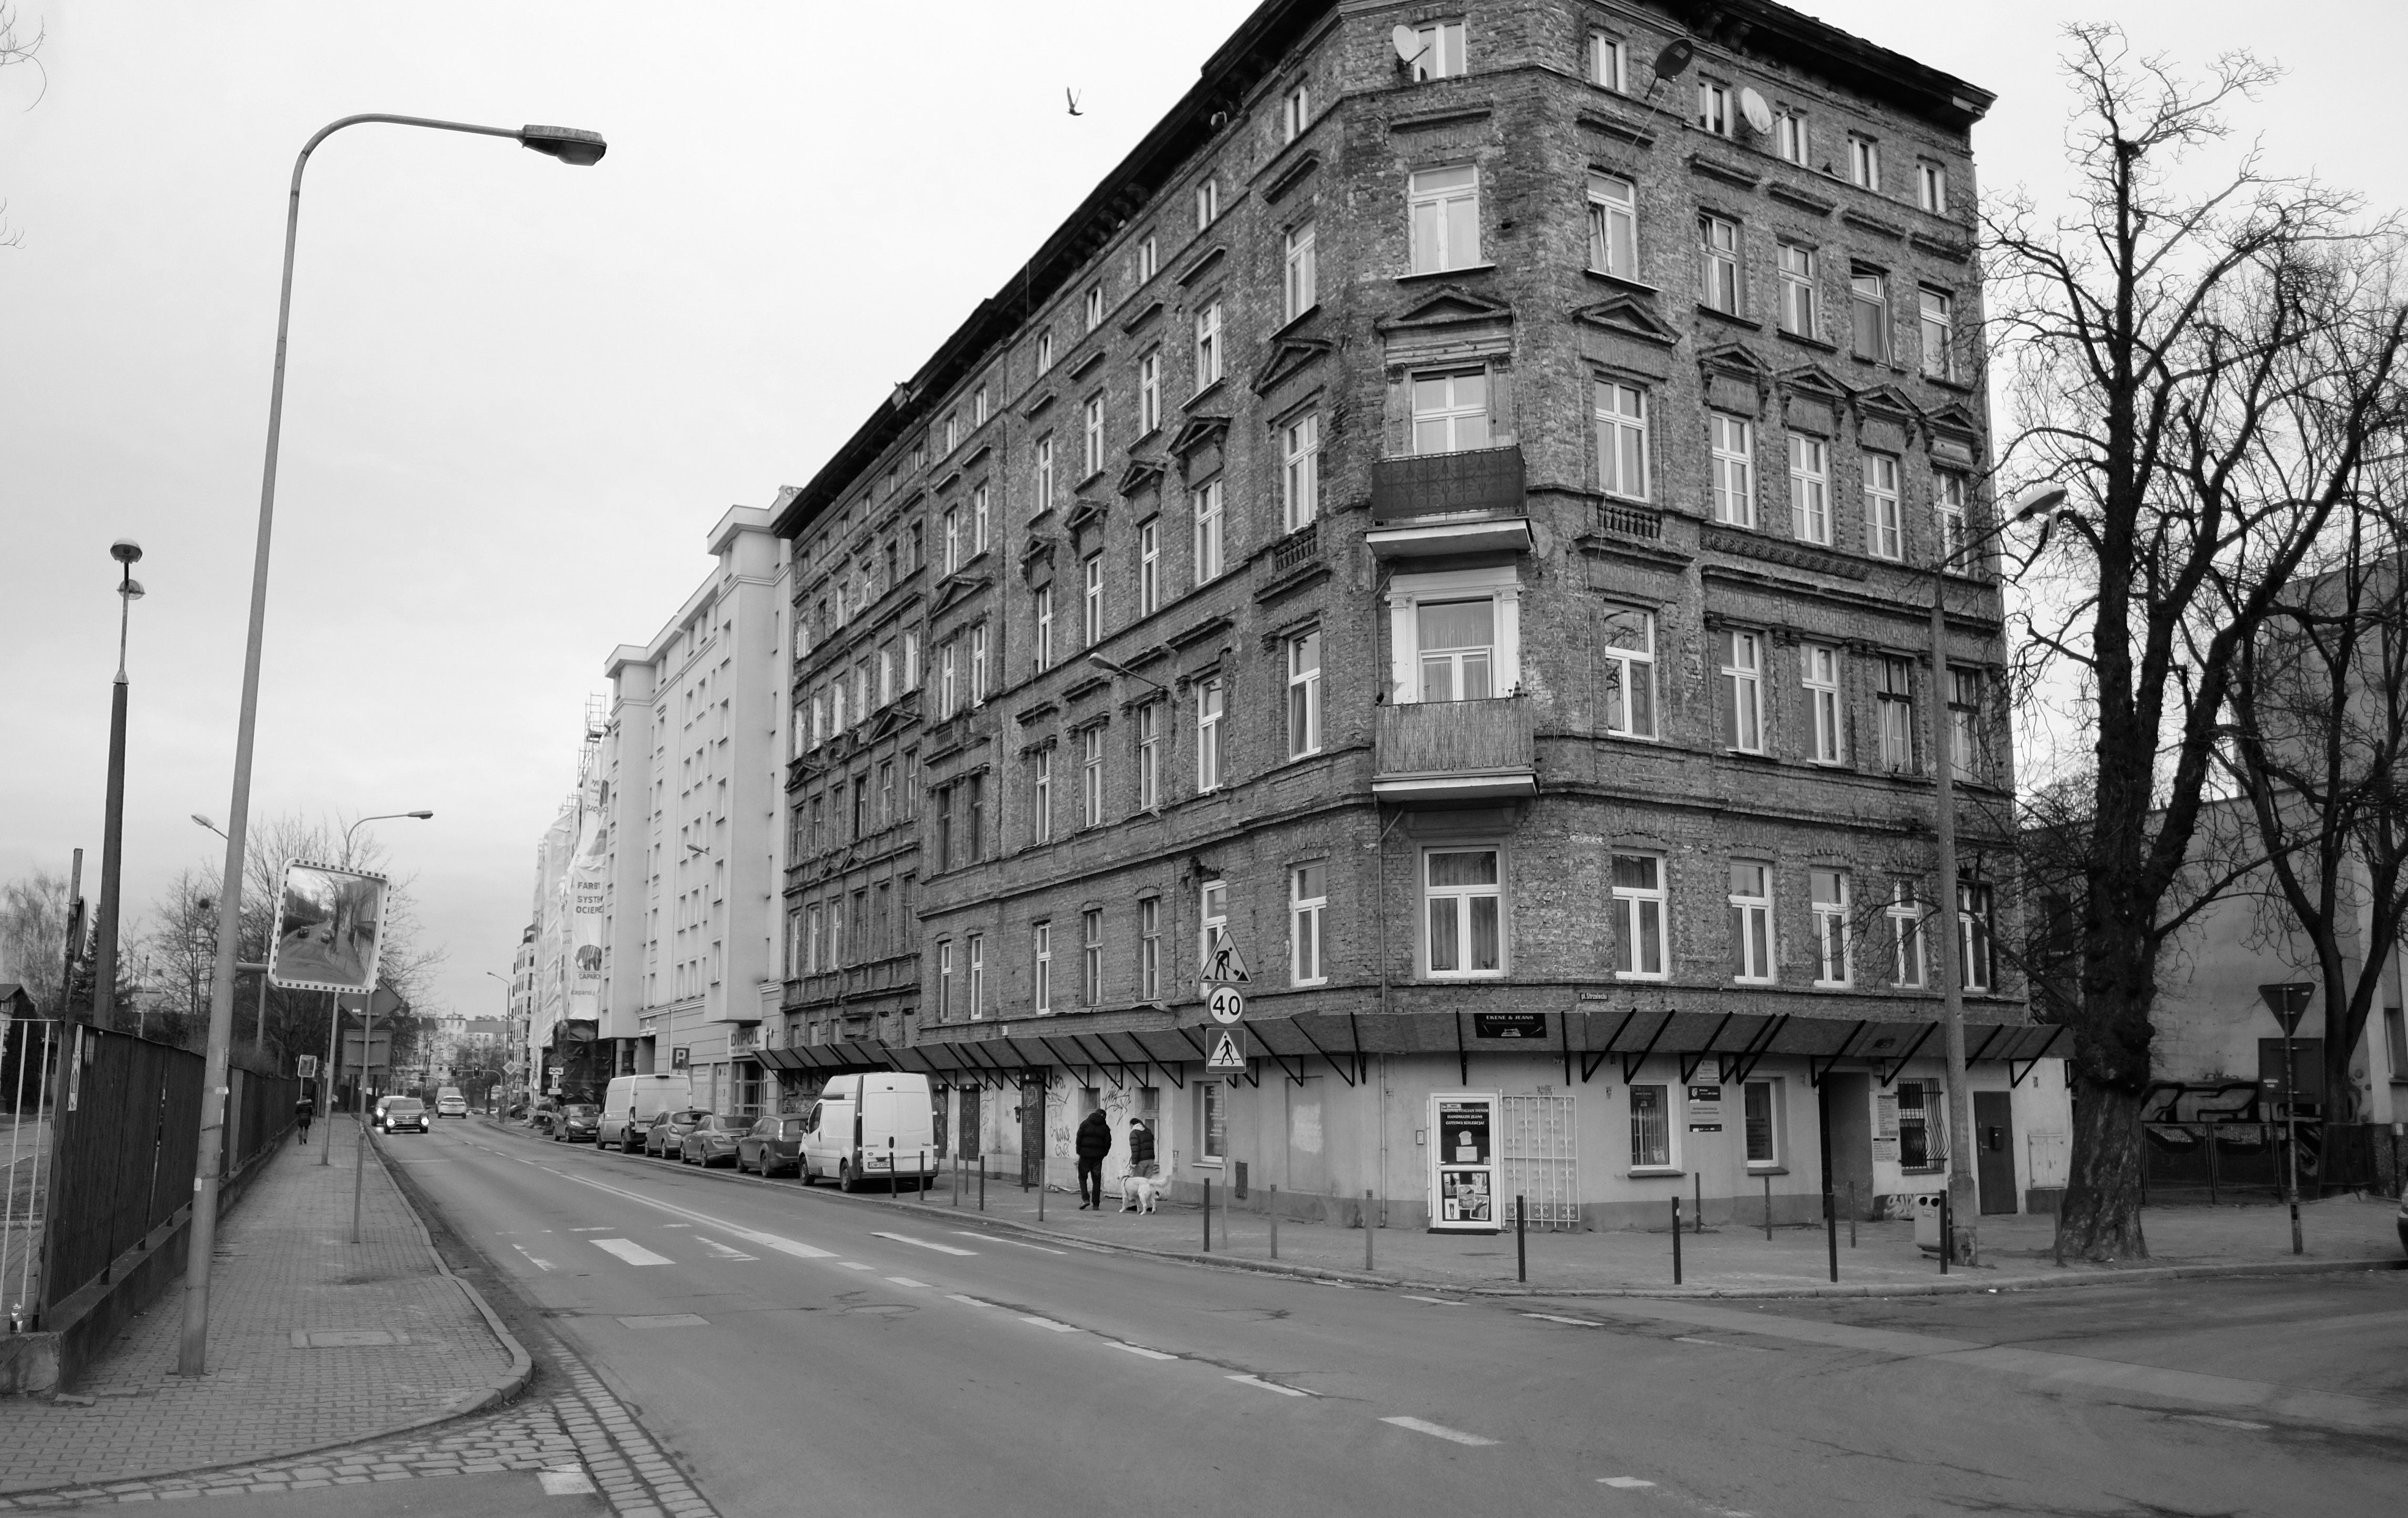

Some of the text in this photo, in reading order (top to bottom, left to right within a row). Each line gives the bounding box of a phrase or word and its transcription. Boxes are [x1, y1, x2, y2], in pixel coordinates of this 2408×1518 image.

[1212, 995, 1241, 1015] 40
[730, 1030, 761, 1047] DIPOL
[676, 1049, 686, 1063] P
